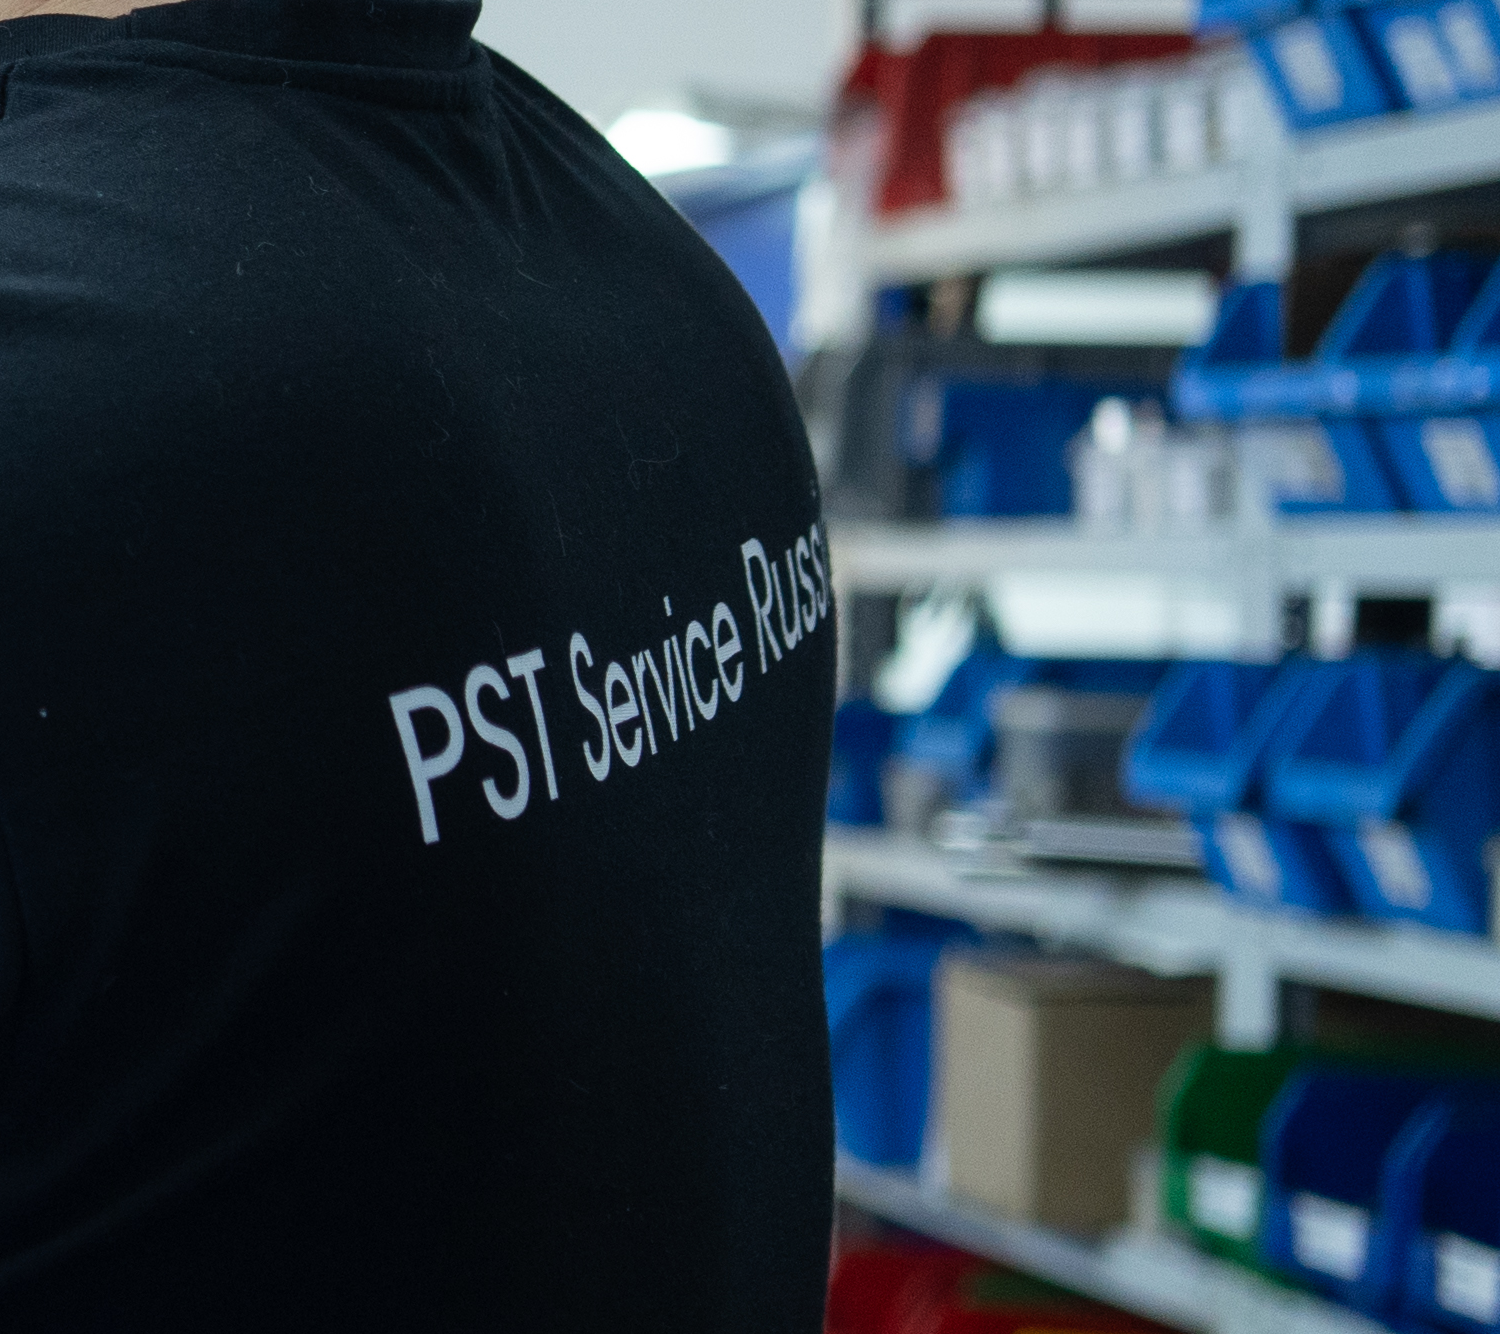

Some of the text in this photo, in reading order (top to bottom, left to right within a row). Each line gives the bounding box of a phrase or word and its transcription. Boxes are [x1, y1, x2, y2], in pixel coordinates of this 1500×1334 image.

[389, 524, 829, 844] PST Service Russ
